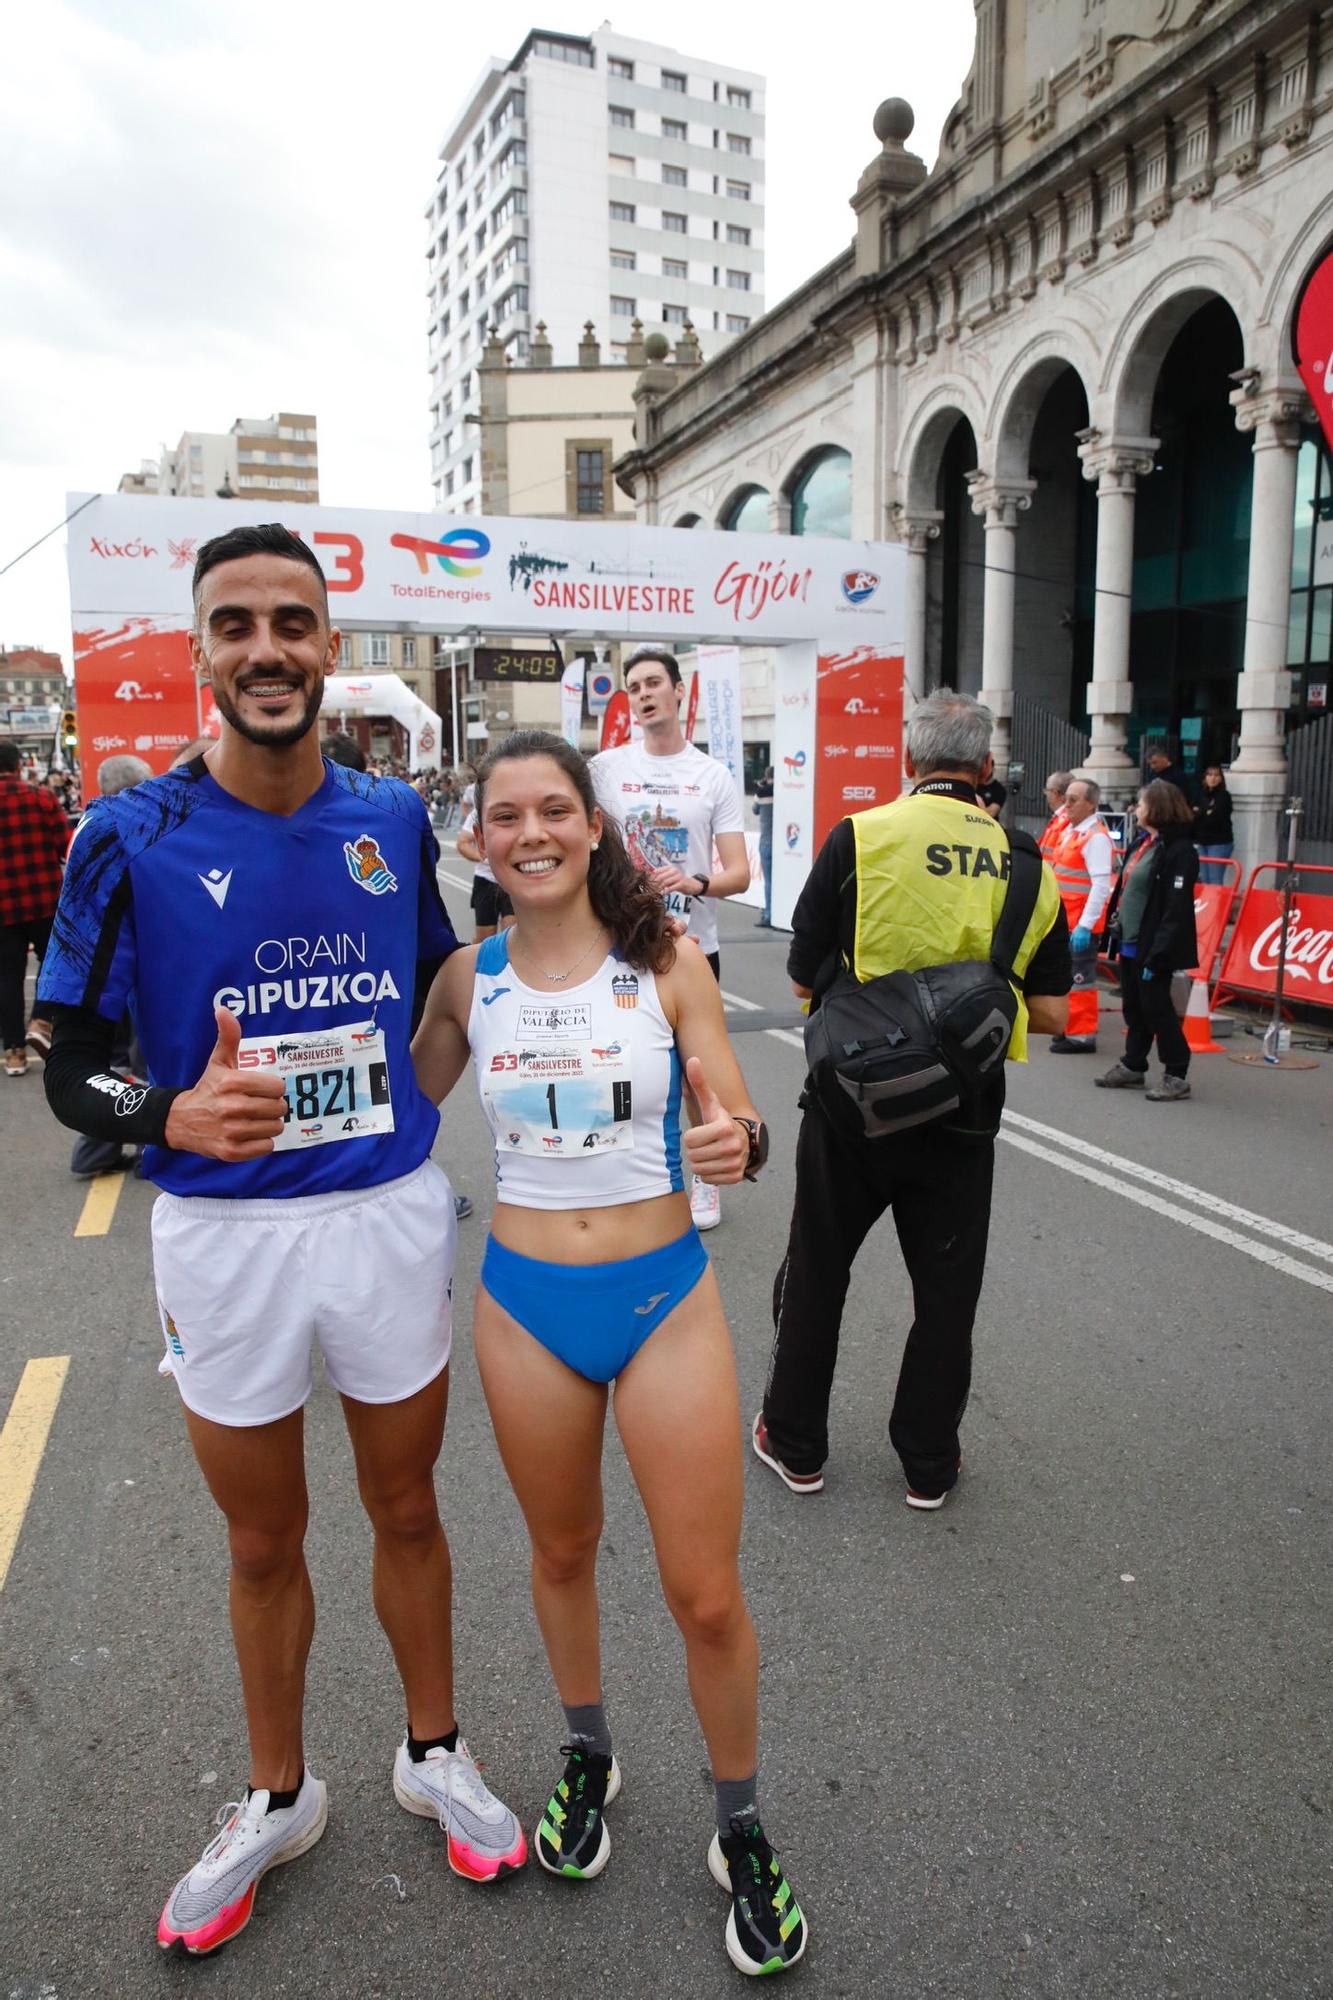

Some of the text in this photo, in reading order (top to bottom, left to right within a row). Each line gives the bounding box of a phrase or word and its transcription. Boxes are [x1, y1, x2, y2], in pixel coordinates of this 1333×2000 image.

[90, 536, 159, 559] Xixón
[288, 531, 364, 592] 3
[391, 583, 492, 604] TotalEnergies
[533, 580, 696, 614] SANSILVESTRE
[713, 559, 812, 622] Gijón
[621, 783, 642, 793] 53
[254, 931, 367, 974] ORAIN
[212, 969, 401, 1018] GIPUZKOA
[238, 1045, 344, 1069] 53 SANSILVESTRE
[490, 1053, 583, 1073] 53 SANSILVESTRE
[546, 1083, 559, 1130] 1
